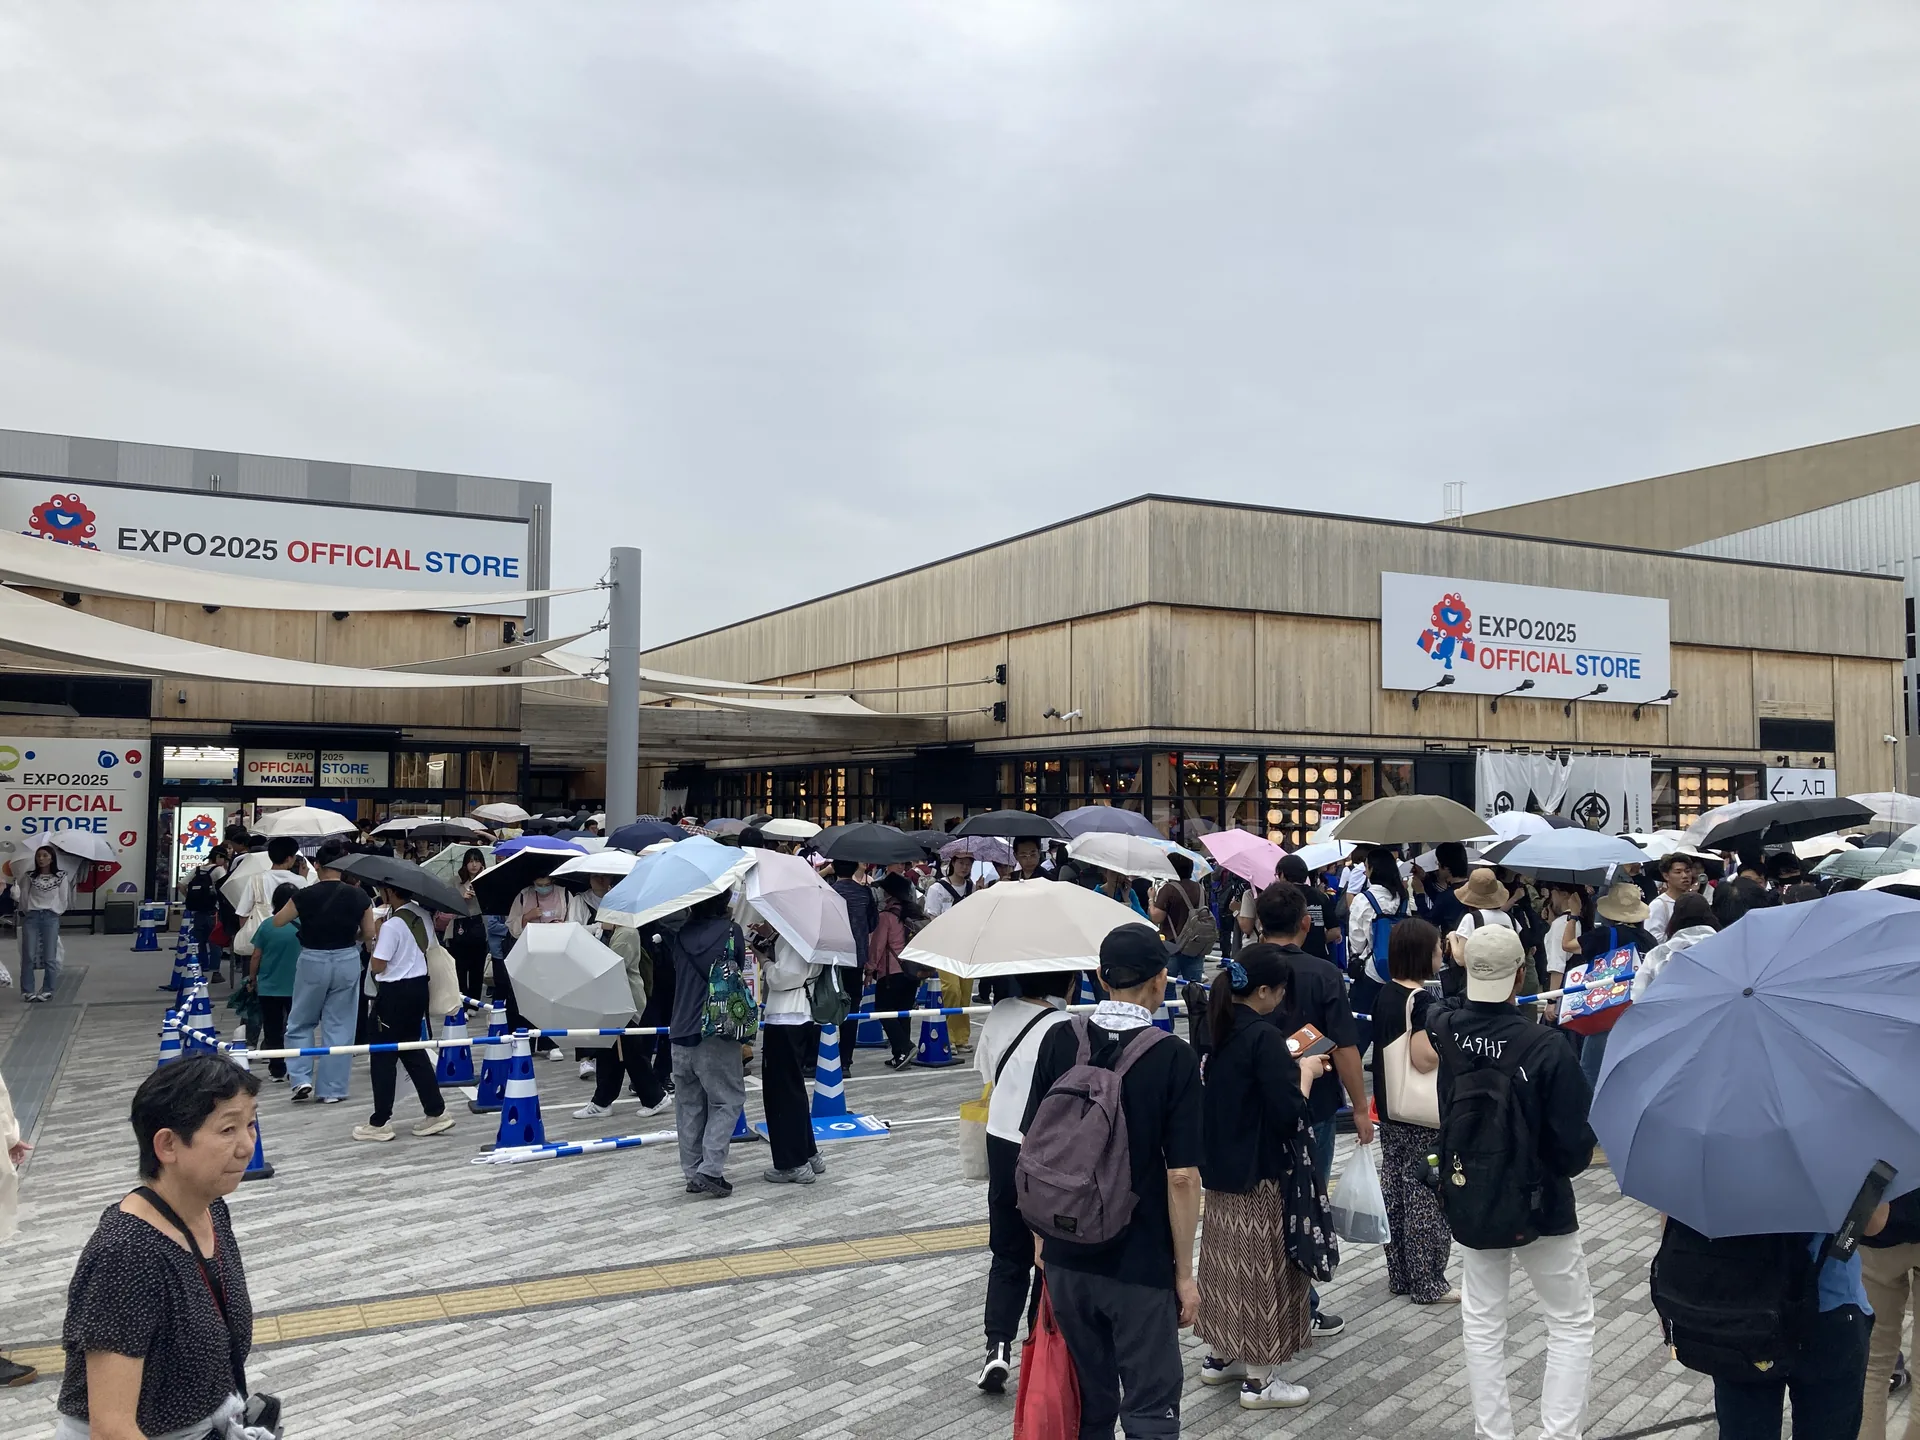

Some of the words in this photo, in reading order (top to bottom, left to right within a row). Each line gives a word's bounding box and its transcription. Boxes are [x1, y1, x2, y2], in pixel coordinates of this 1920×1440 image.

[118, 527, 278, 561] EXPO2025
[287, 540, 421, 571] OFFICIAL
[425, 551, 519, 579] STORE
[1479, 615, 1577, 643] EXPO2025
[1479, 647, 1573, 675] OFFICIAL
[1575, 654, 1641, 679] STORE
[286, 752, 314, 761] EXPO
[322, 753, 344, 761] 2025
[248, 761, 314, 773] OFFICIAL
[322, 763, 369, 775] STORE
[23, 773, 109, 786] EXPO2025
[260, 775, 314, 784] MARUZEN
[321, 776, 375, 785] JUNKUDO
[1801, 779, 1825, 795] 入口
[6, 793, 123, 812] OFFICIAL
[21, 816, 108, 834] STORE
